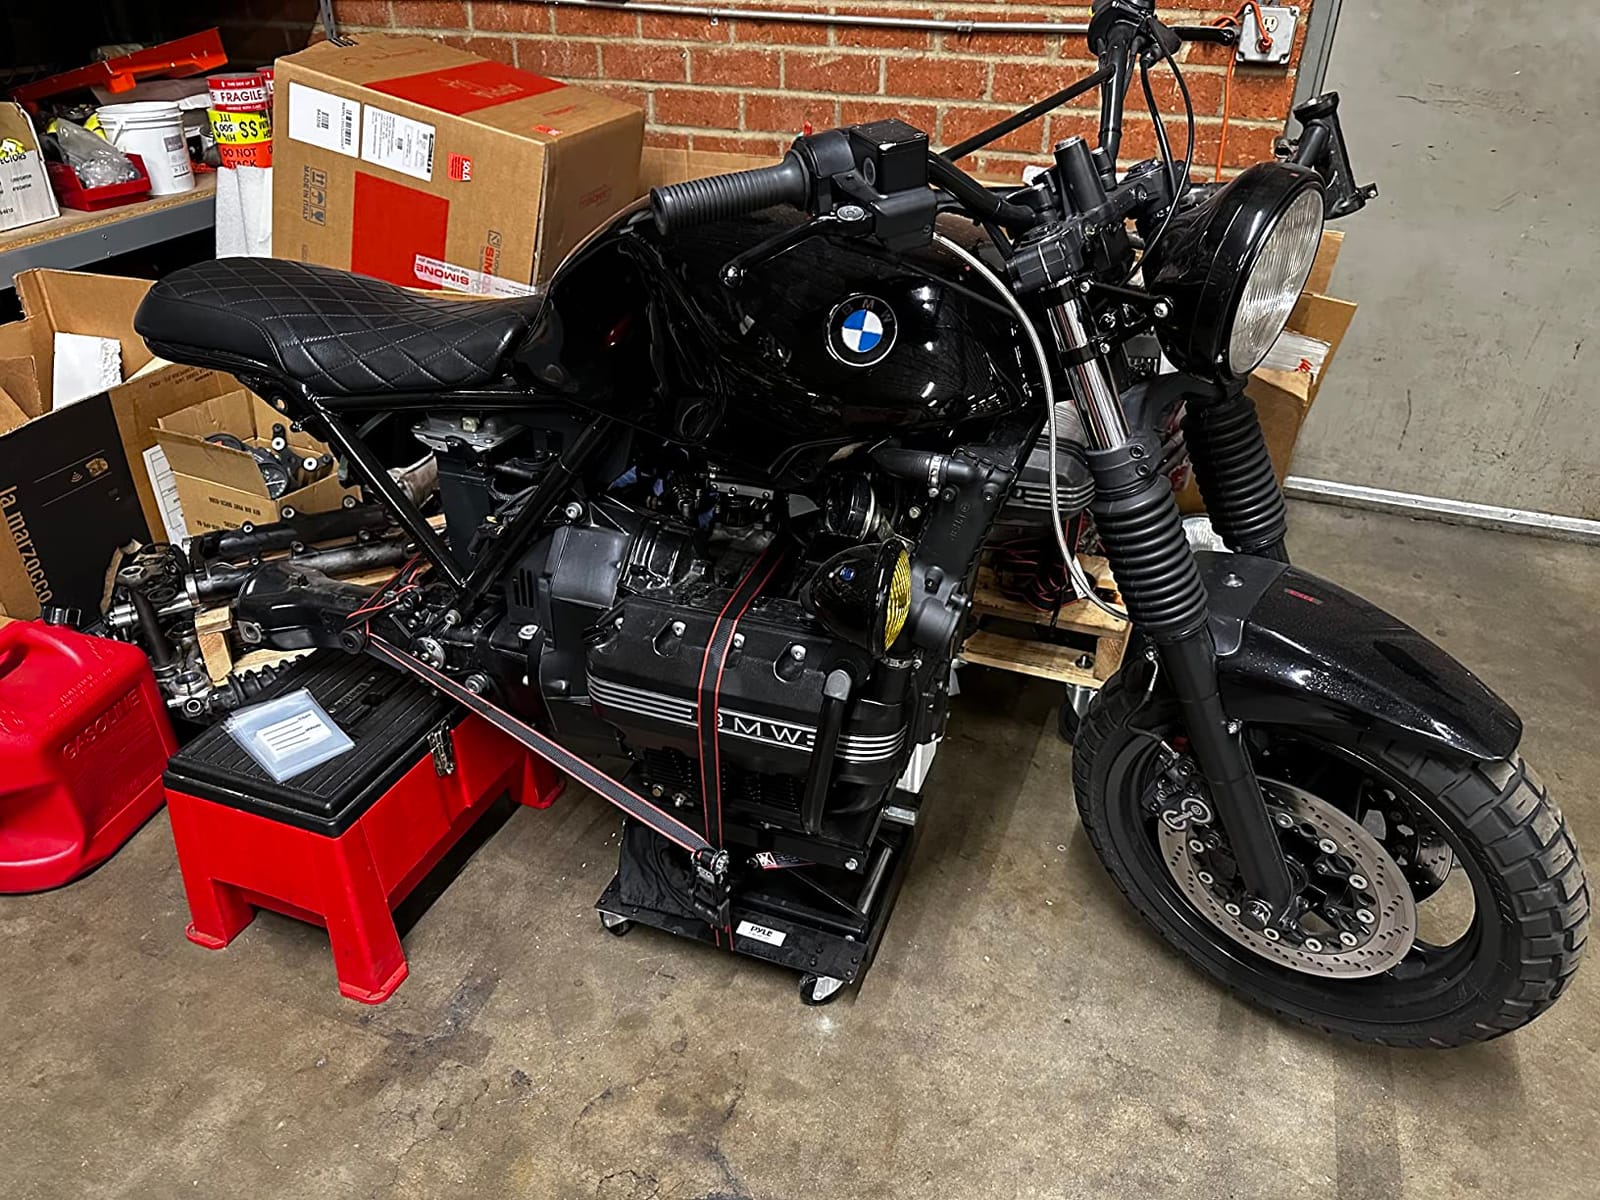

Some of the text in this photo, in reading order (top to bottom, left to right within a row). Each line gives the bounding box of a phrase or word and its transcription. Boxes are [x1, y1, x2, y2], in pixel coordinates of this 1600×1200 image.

[220, 90, 263, 102] FRAGILE
[222, 147, 257, 157] DO NOT
[303, 188, 310, 198] IN
[841, 299, 892, 323] BMW
[0, 485, 53, 604] la marzocco
[750, 925, 773, 937] PYLE
